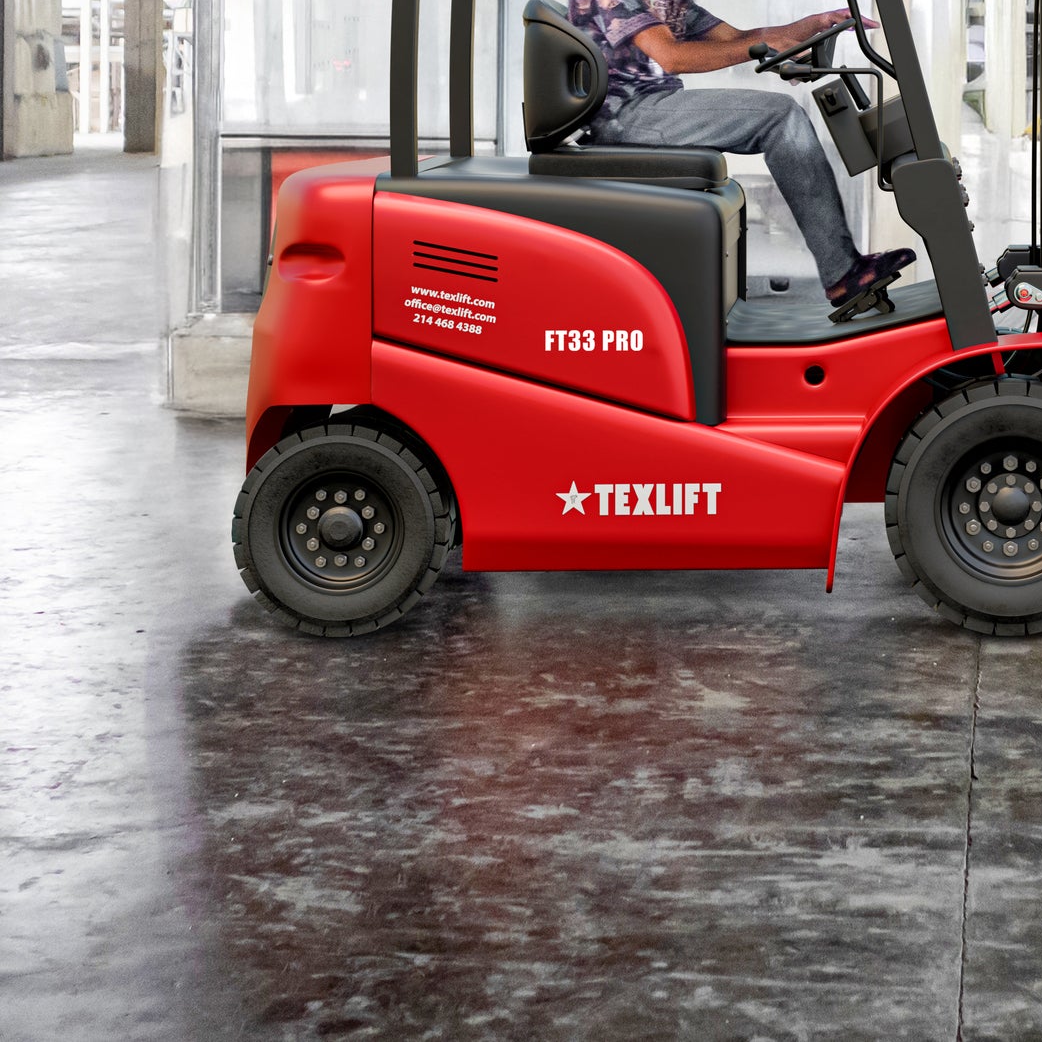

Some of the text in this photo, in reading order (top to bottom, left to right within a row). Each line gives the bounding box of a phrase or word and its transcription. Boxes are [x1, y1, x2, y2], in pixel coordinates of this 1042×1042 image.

[411, 286, 495, 309] www.texlift.com
[404, 298, 497, 324] office@texlift.com
[413, 313, 482, 335] 214 468 4388
[544, 329, 644, 352] FT33 PRO
[594, 483, 722, 516] TEXLIFT
